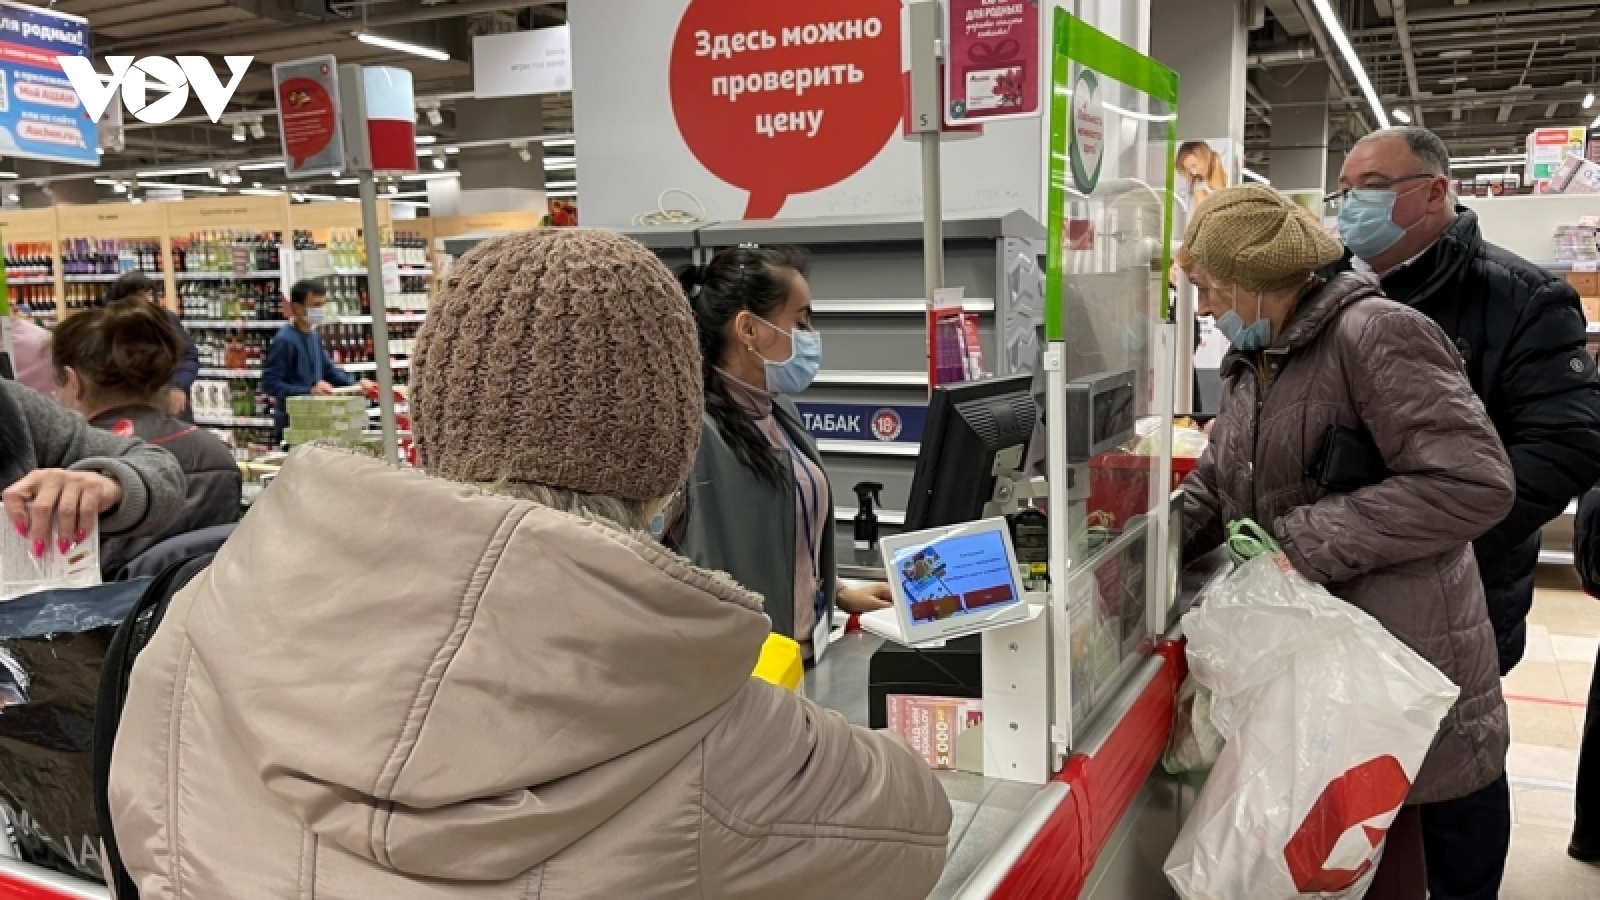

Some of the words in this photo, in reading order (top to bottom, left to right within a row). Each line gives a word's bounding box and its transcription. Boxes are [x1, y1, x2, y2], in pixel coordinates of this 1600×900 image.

[694, 29, 777, 60] Здесь
[781, 16, 883, 47] можно
[712, 63, 865, 103] проверить
[755, 108, 825, 138] цену
[803, 413, 860, 432] ТАБАК
